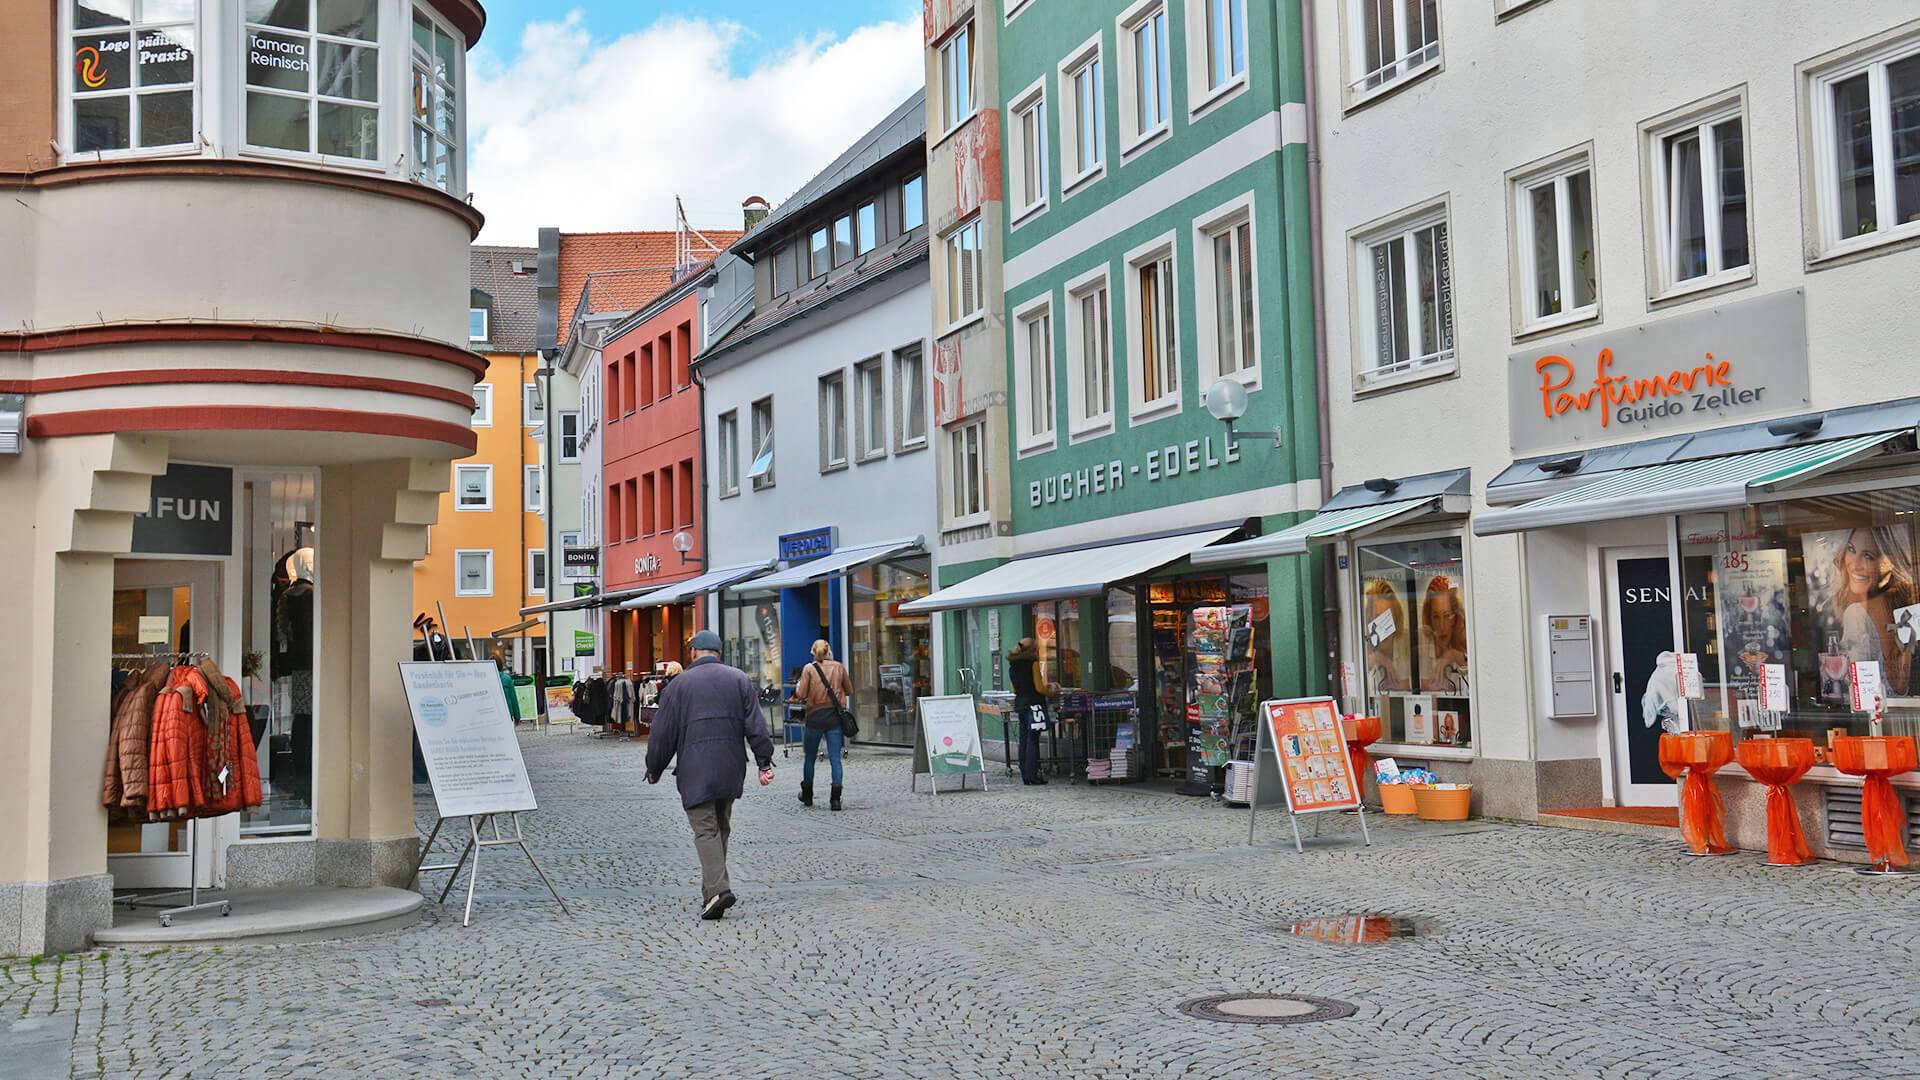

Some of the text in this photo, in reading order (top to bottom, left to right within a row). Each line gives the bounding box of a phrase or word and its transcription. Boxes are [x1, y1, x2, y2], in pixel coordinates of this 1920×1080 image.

[250, 35, 305, 55] Tamara
[139, 48, 188, 64] Praxis
[251, 51, 310, 72] Reinisch
[1535, 347, 1734, 428] Parfümerie
[1616, 385, 1766, 425] Guido Zeller
[567, 552, 595, 562] BONITA
[634, 553, 659, 577] BONITA
[1722, 550, 1749, 572] 185
